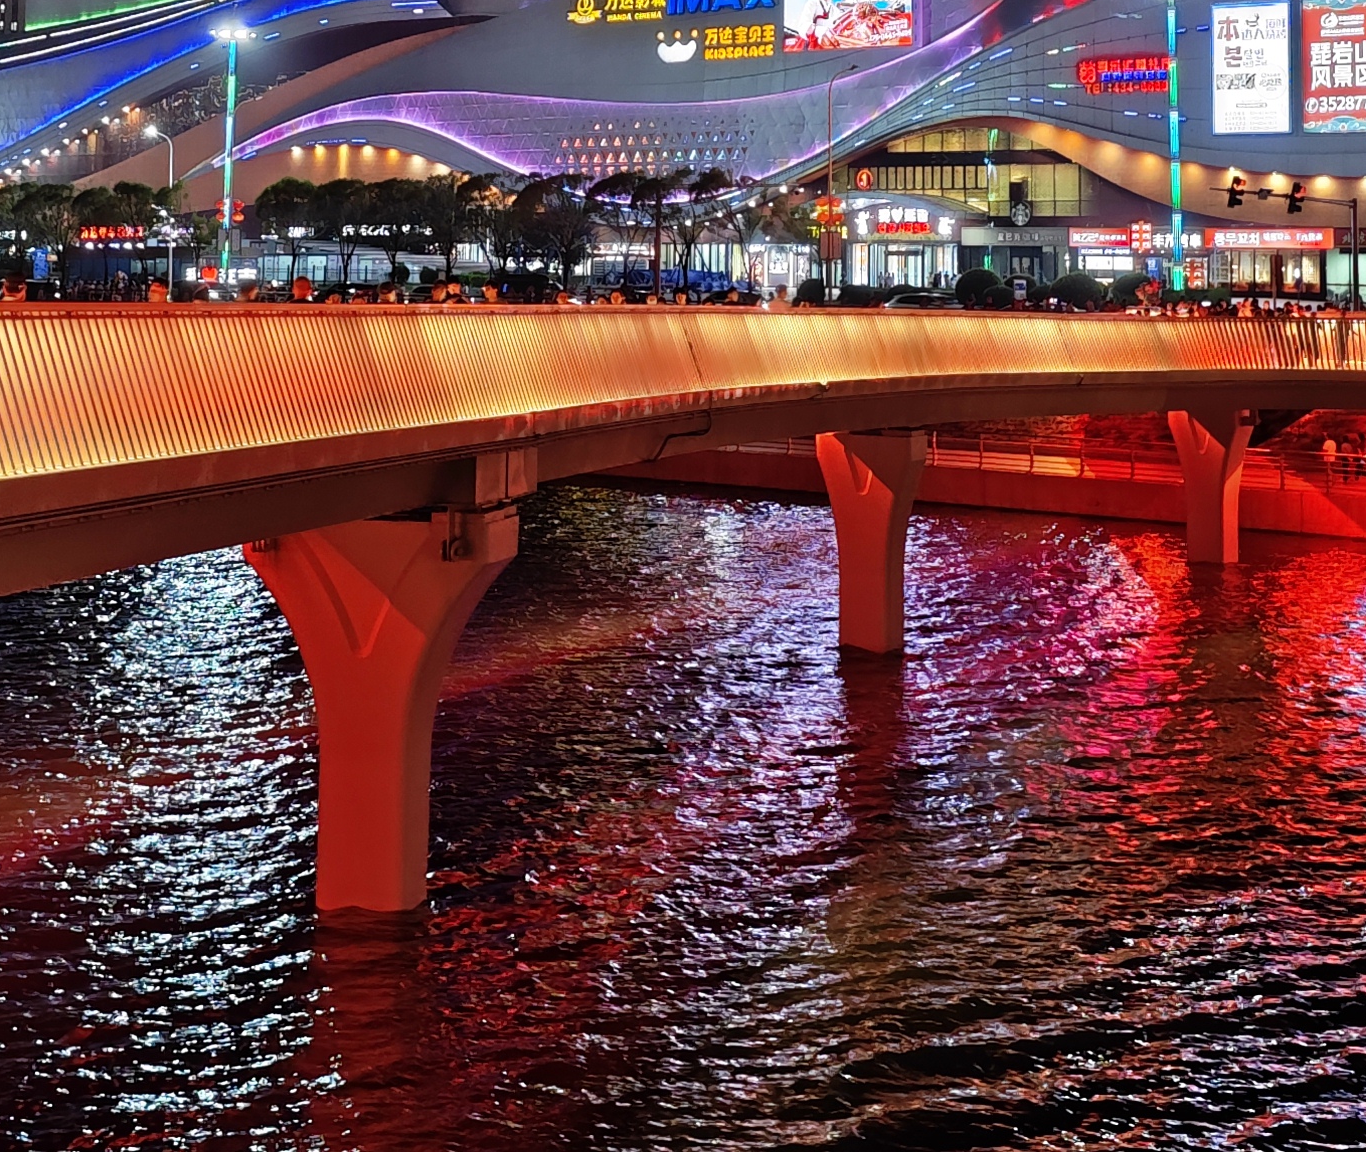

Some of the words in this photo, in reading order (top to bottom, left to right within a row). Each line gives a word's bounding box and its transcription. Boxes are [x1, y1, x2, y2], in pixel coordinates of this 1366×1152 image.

[704, 24, 776, 45] 万达宝贝王
[704, 44, 775, 60] KIDSPLACE
